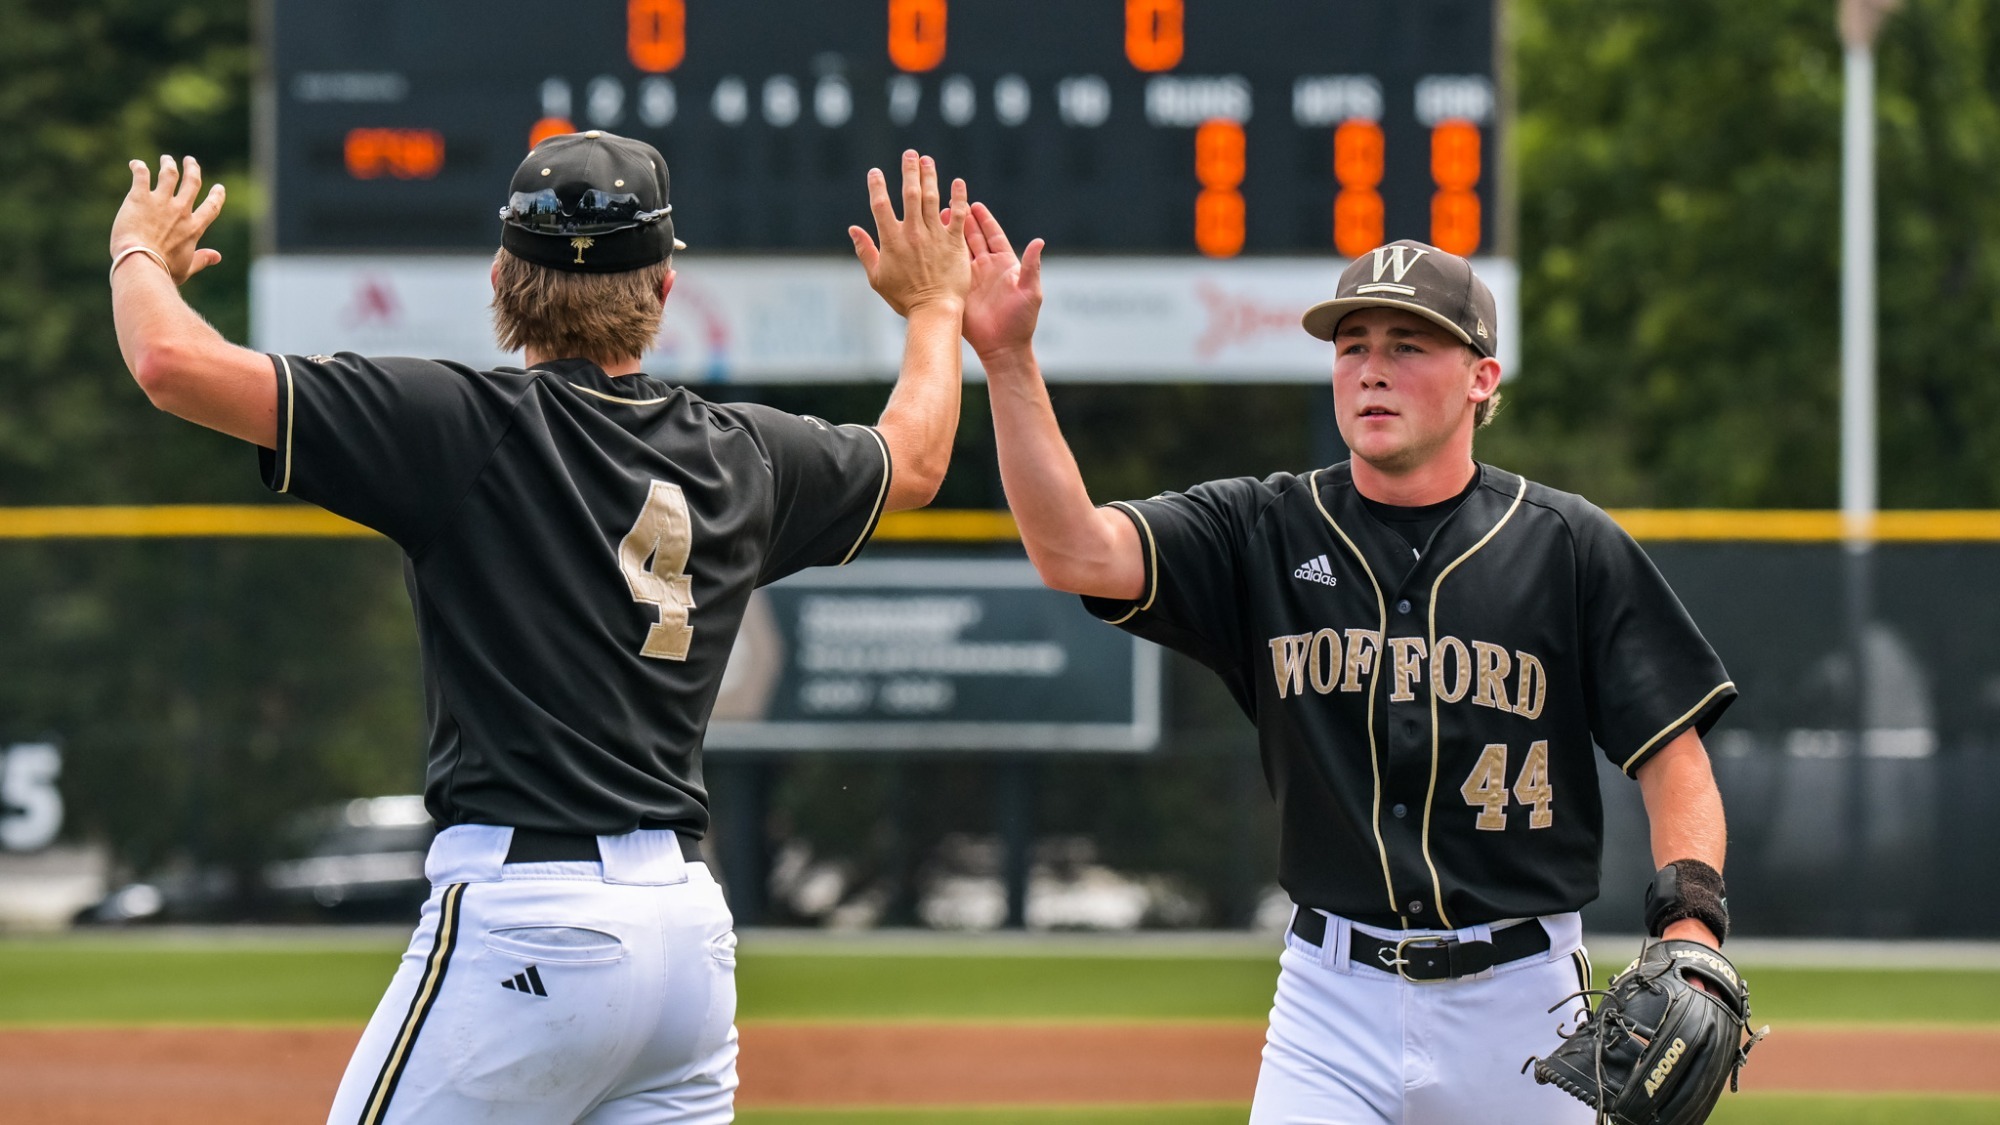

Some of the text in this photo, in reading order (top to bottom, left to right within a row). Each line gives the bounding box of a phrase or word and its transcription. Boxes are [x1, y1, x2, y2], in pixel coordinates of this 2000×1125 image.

[1373, 246, 1429, 282] W
[618, 479, 697, 661] 4
[1294, 568, 1337, 587] adidas
[1269, 627, 1547, 720] WOFFORD
[1460, 740, 1552, 830] 44
[1644, 1037, 1686, 1098] A2000
